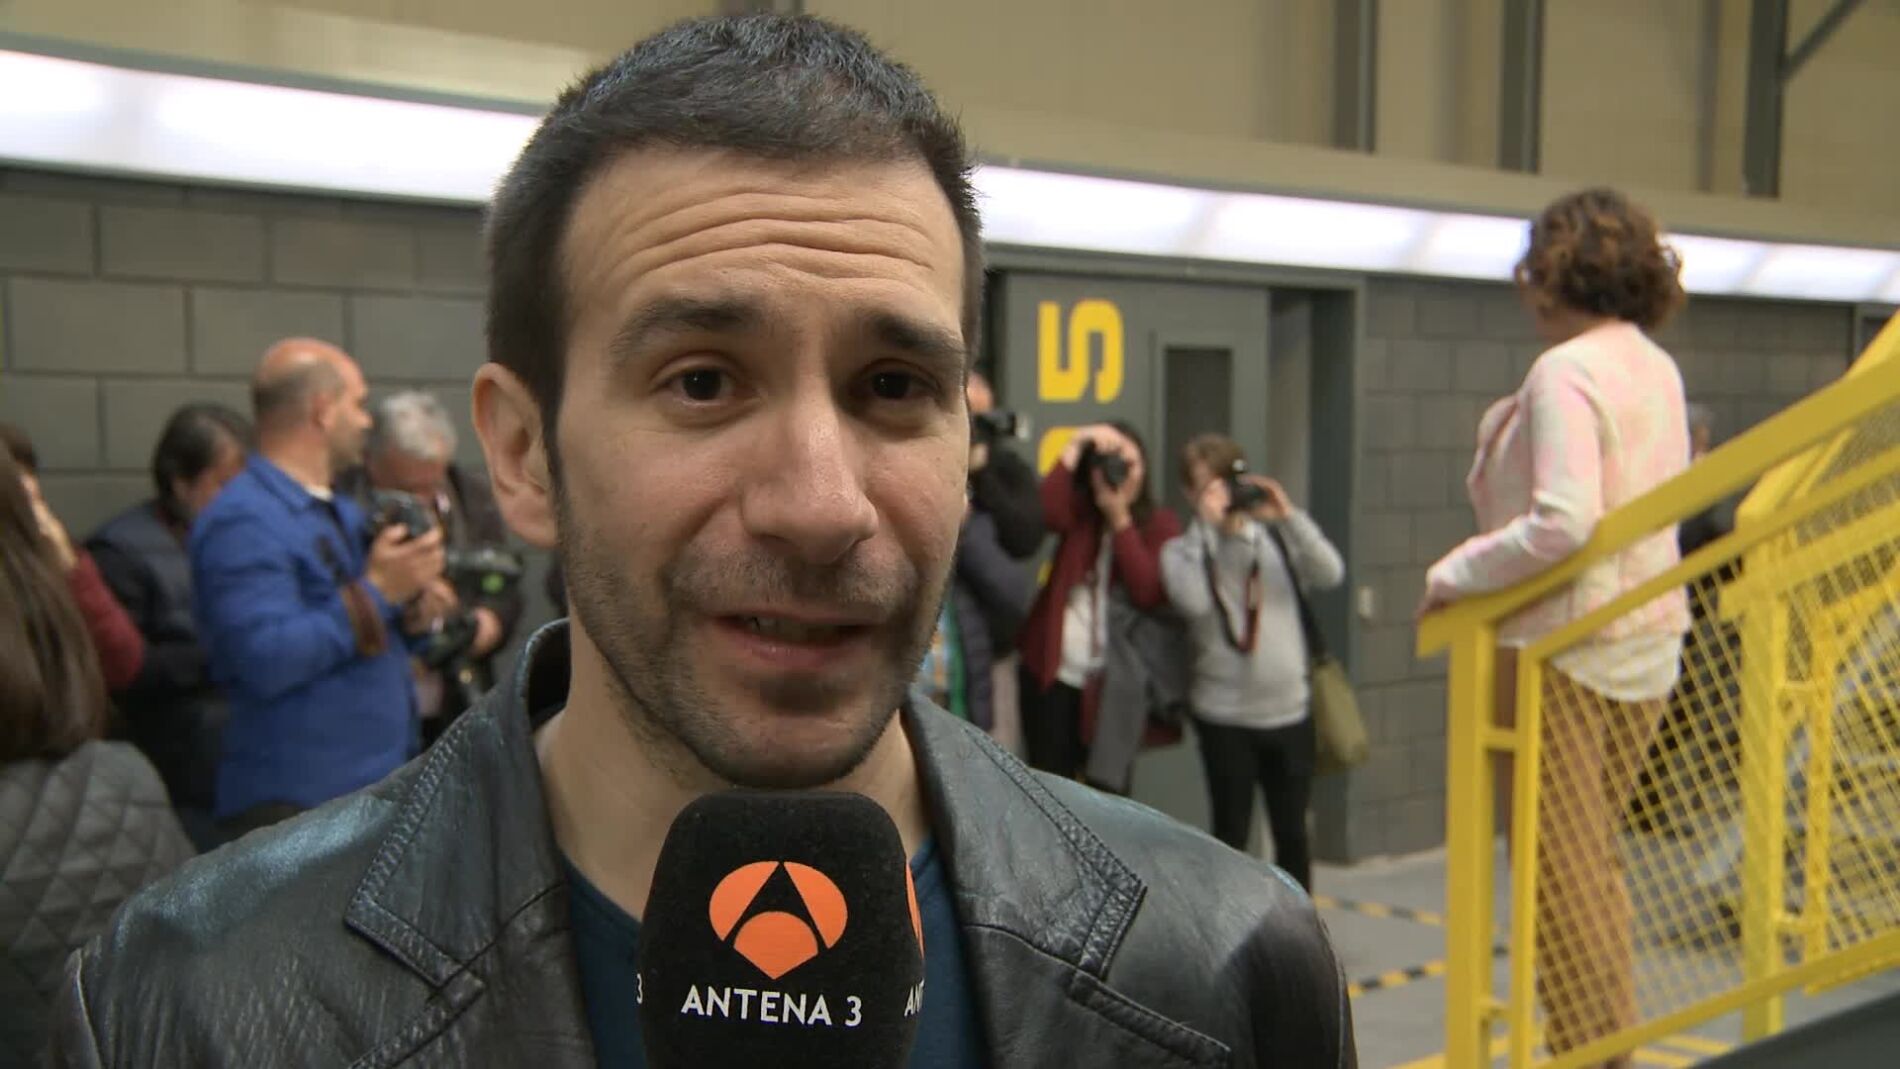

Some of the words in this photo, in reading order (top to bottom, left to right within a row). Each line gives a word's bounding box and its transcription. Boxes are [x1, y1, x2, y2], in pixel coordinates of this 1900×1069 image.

[636, 973, 643, 1004] 3
[680, 984, 833, 1026] ANTENA
[844, 995, 863, 1027] 3
